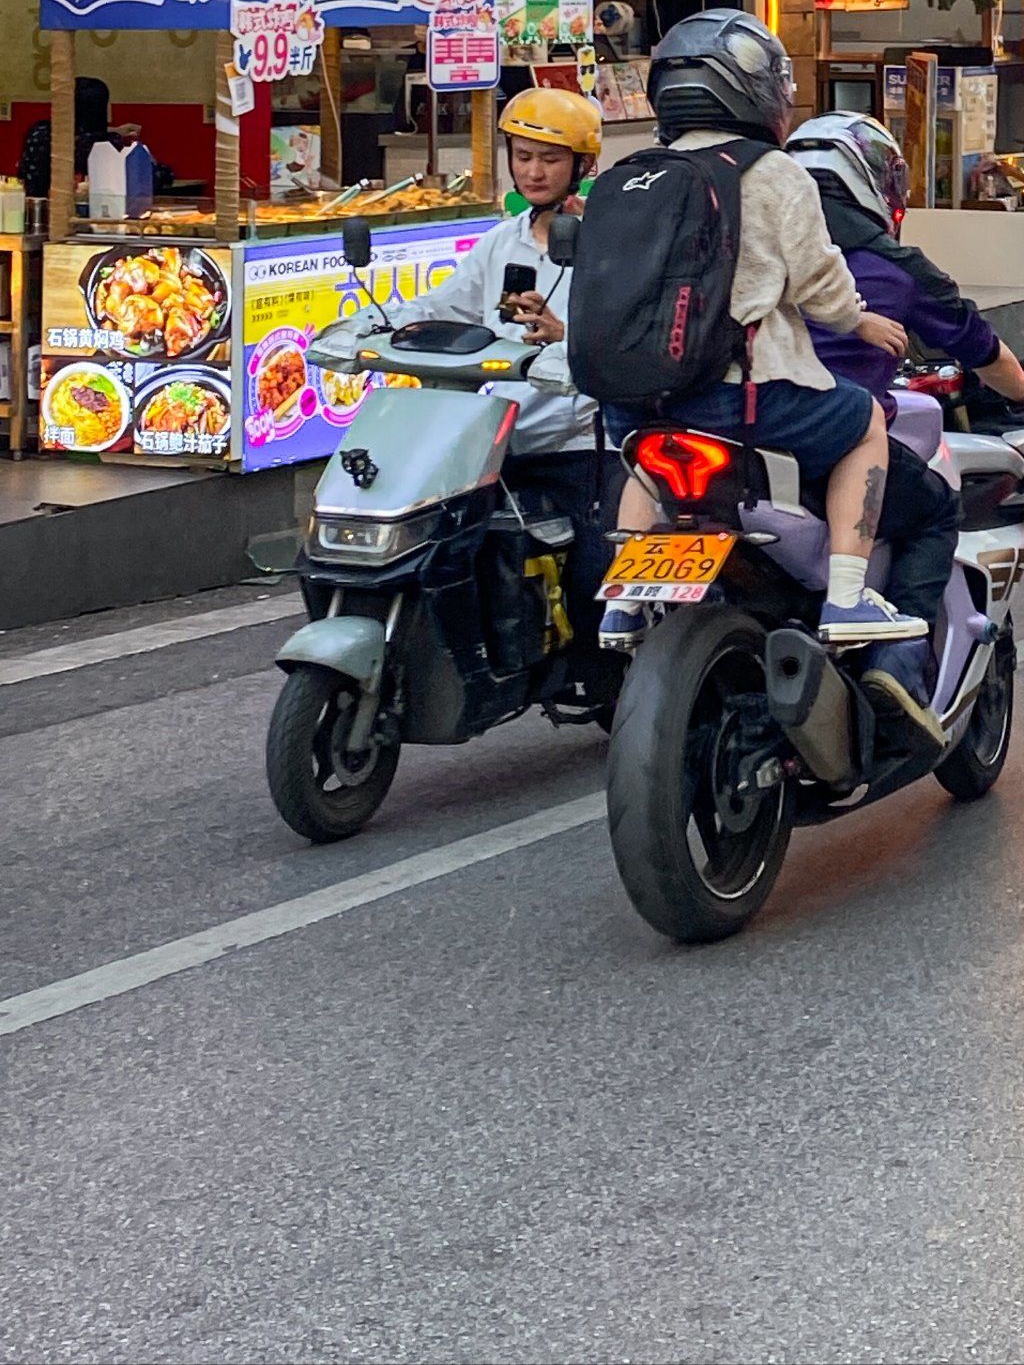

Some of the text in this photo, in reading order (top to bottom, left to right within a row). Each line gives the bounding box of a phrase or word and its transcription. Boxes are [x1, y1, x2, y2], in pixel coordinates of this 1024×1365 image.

[254, 34, 288, 76] 9.9
[269, 258, 318, 277] KOREAN
[47, 328, 126, 350] 石锅黄焖鸡
[43, 425, 75, 446] 拌面
